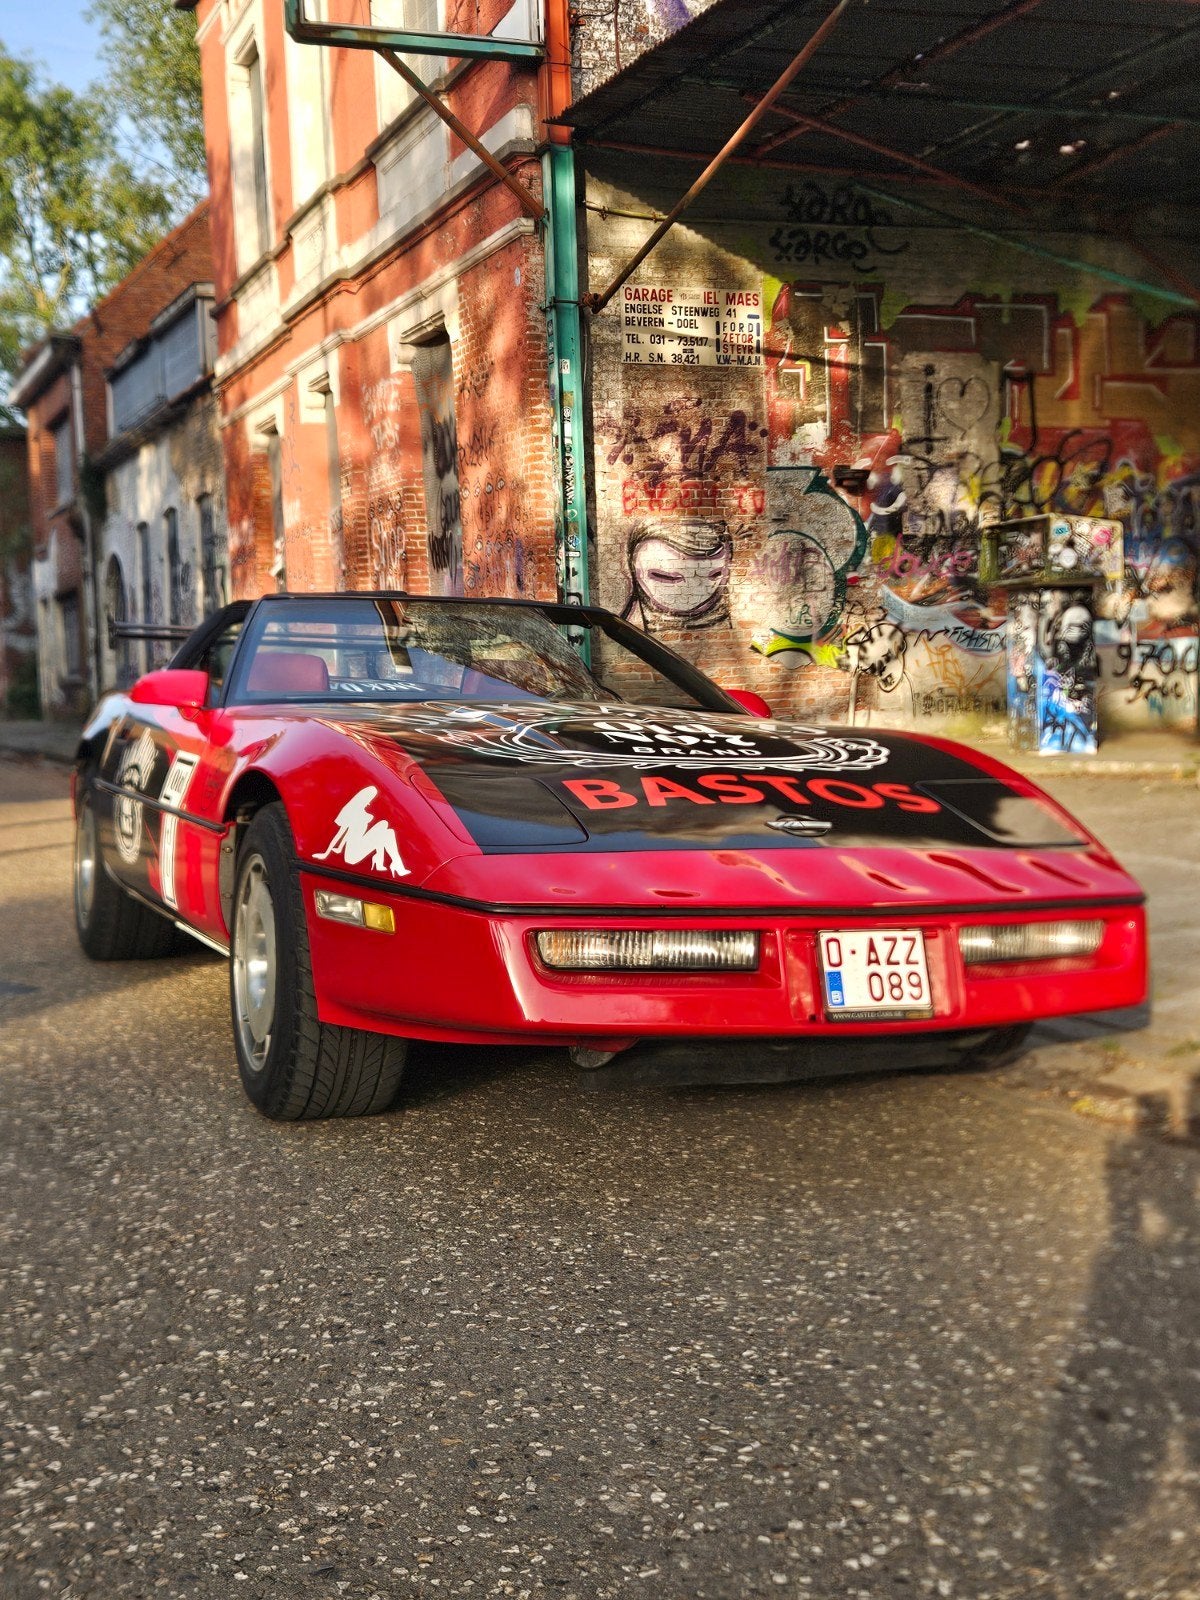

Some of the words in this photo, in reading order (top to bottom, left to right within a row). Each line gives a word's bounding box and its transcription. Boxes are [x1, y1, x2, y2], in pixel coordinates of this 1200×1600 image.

[624, 286, 673, 303] GARAGE
[725, 292, 760, 307] MAES
[624, 303, 663, 315] ENGELSE
[671, 306, 720, 318] STEENWEG
[726, 308, 737, 318] 41
[625, 317, 665, 328] BEVEREN
[677, 319, 699, 329] DOEL
[722, 322, 754, 333] FORD
[626, 333, 645, 344] TEL.
[650, 334, 665, 345] 031
[722, 333, 754, 343] ZETOR
[722, 344, 754, 354] STEYR
[648, 353, 666, 363] S.N.
[632, 746, 762, 756] BRAND
[562, 773, 943, 815] BASTOS
[868, 971, 923, 1002] 089
